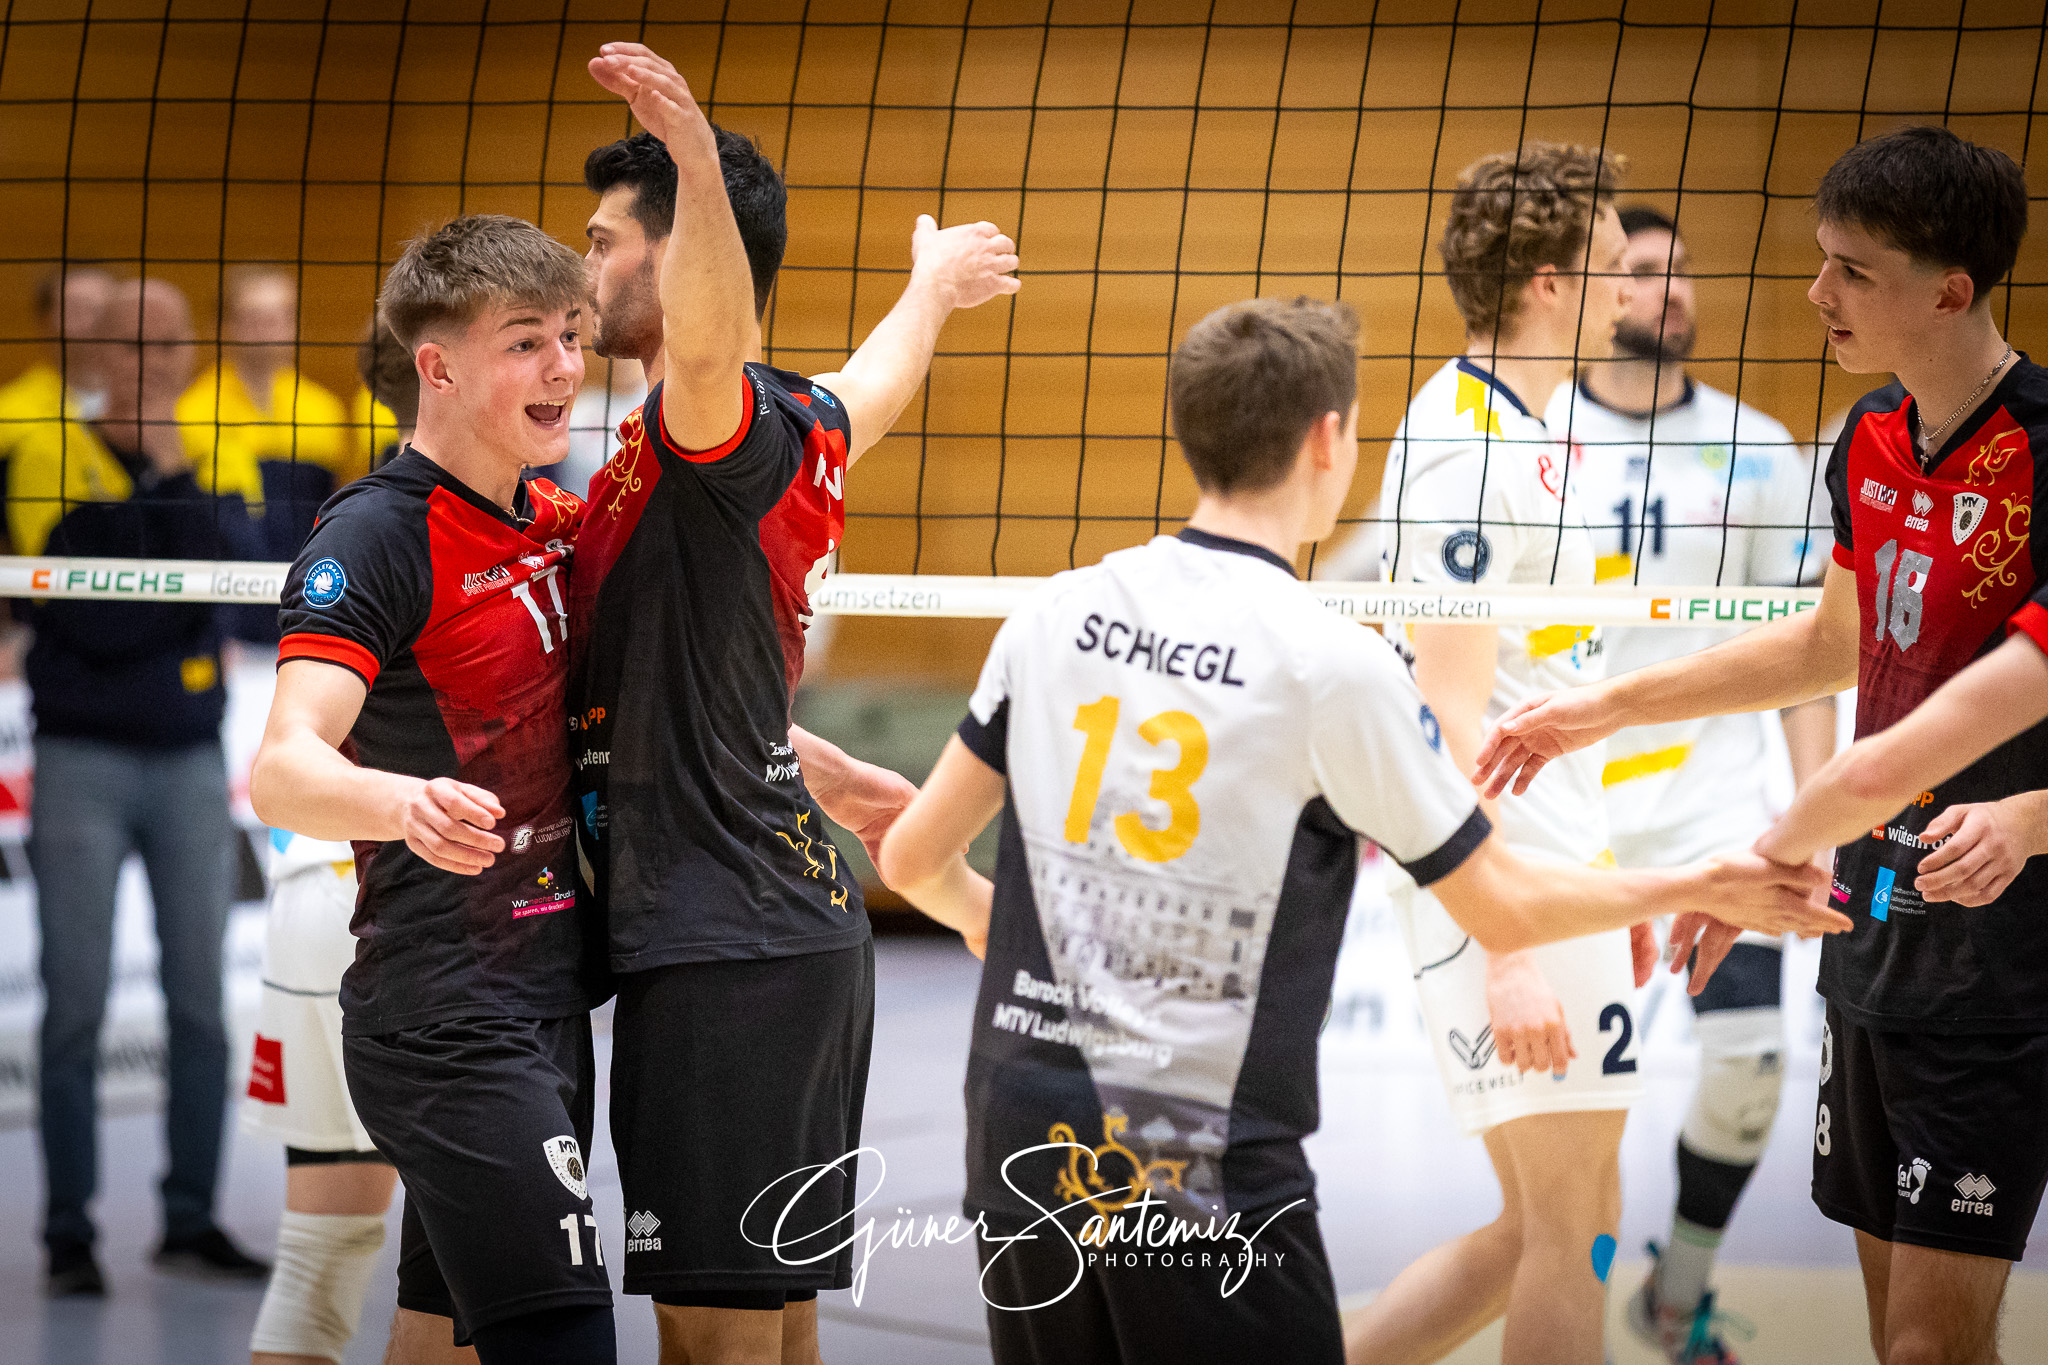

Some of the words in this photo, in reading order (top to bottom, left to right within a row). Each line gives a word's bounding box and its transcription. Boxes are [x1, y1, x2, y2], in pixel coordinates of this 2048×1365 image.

[1612, 496, 1664, 555] 11
[66, 570, 185, 593] FUCHS
[210, 571, 277, 597] Ideen
[817, 586, 942, 611] umsetzen
[1364, 595, 1492, 618] umsetzen
[1075, 612, 1246, 688] SCHIEGL
[1063, 695, 1209, 864] 13
[1013, 969, 1075, 1007] Barock
[1598, 1002, 1638, 1077] 2
